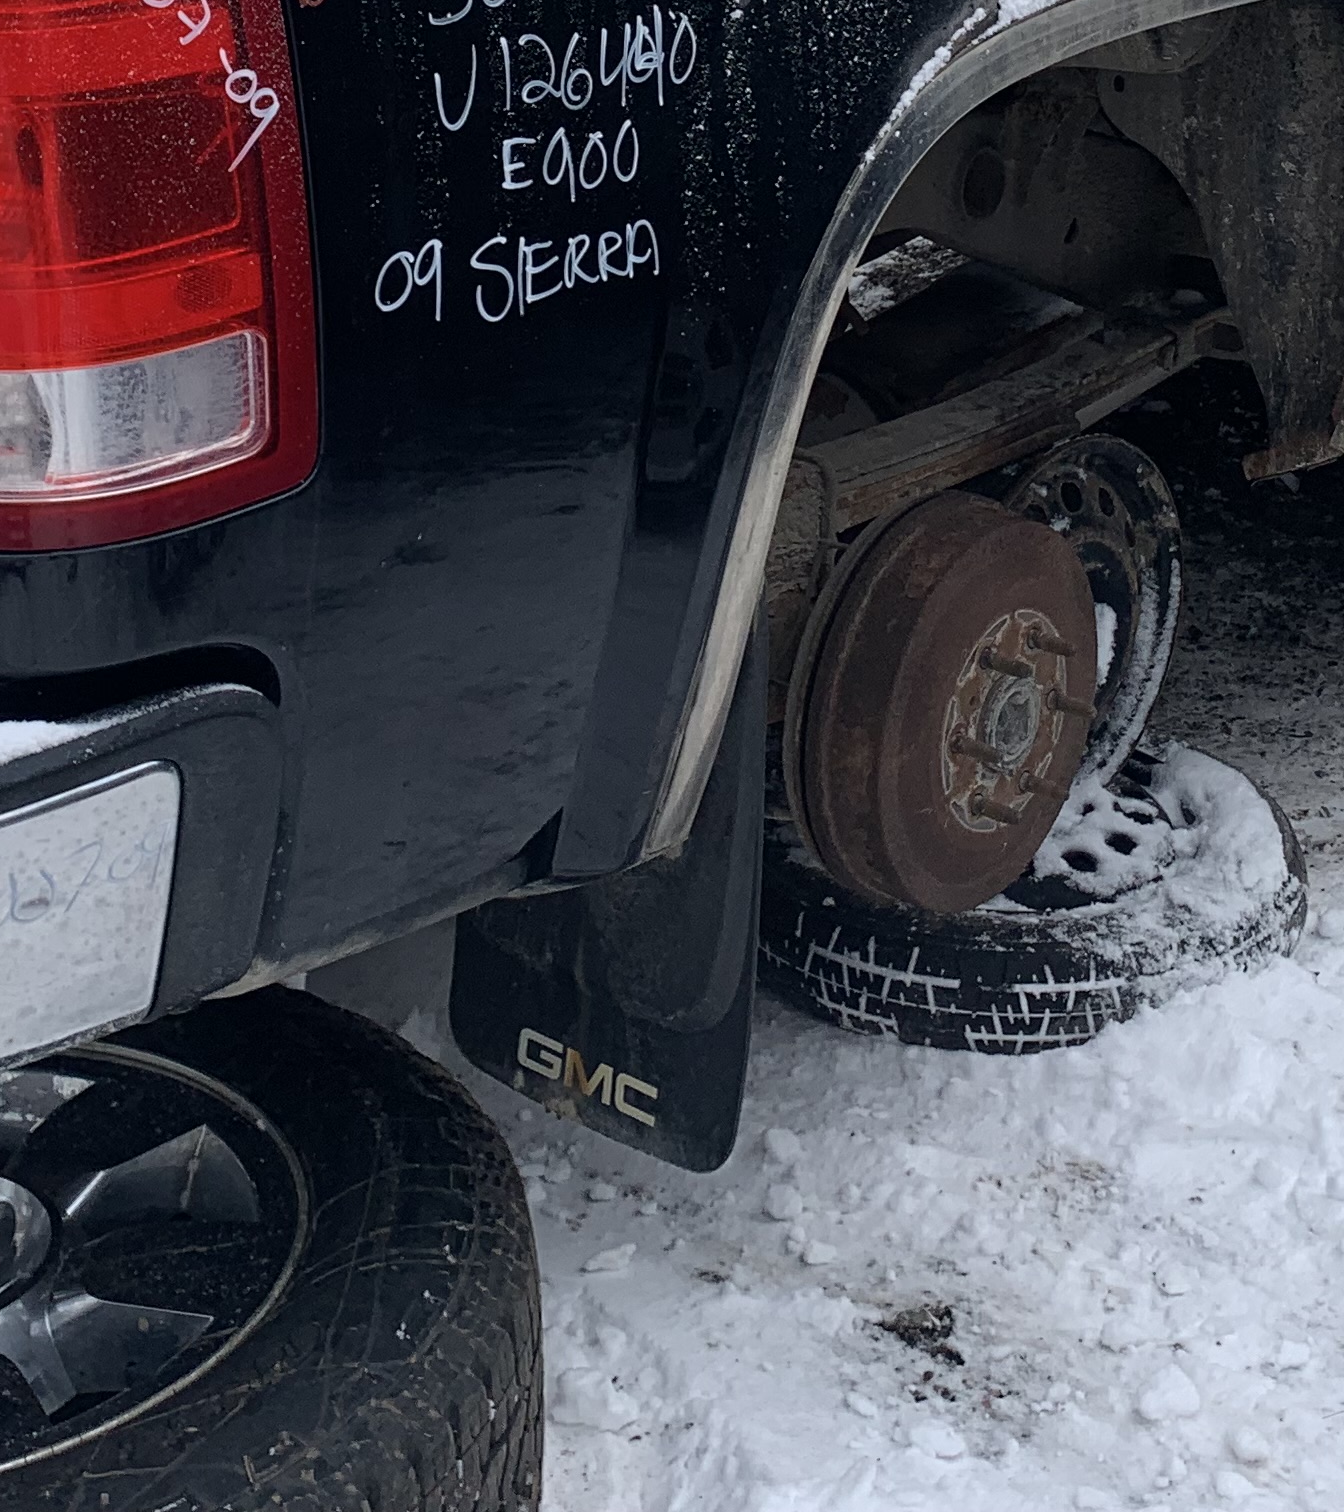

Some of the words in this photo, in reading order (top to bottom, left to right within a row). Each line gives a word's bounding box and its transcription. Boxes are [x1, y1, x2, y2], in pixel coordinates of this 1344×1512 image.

[502, 119, 640, 203] E900
[375, 238, 443, 322] 09
[470, 218, 660, 322] SIERRA
[517, 1027, 658, 1127] GMC
